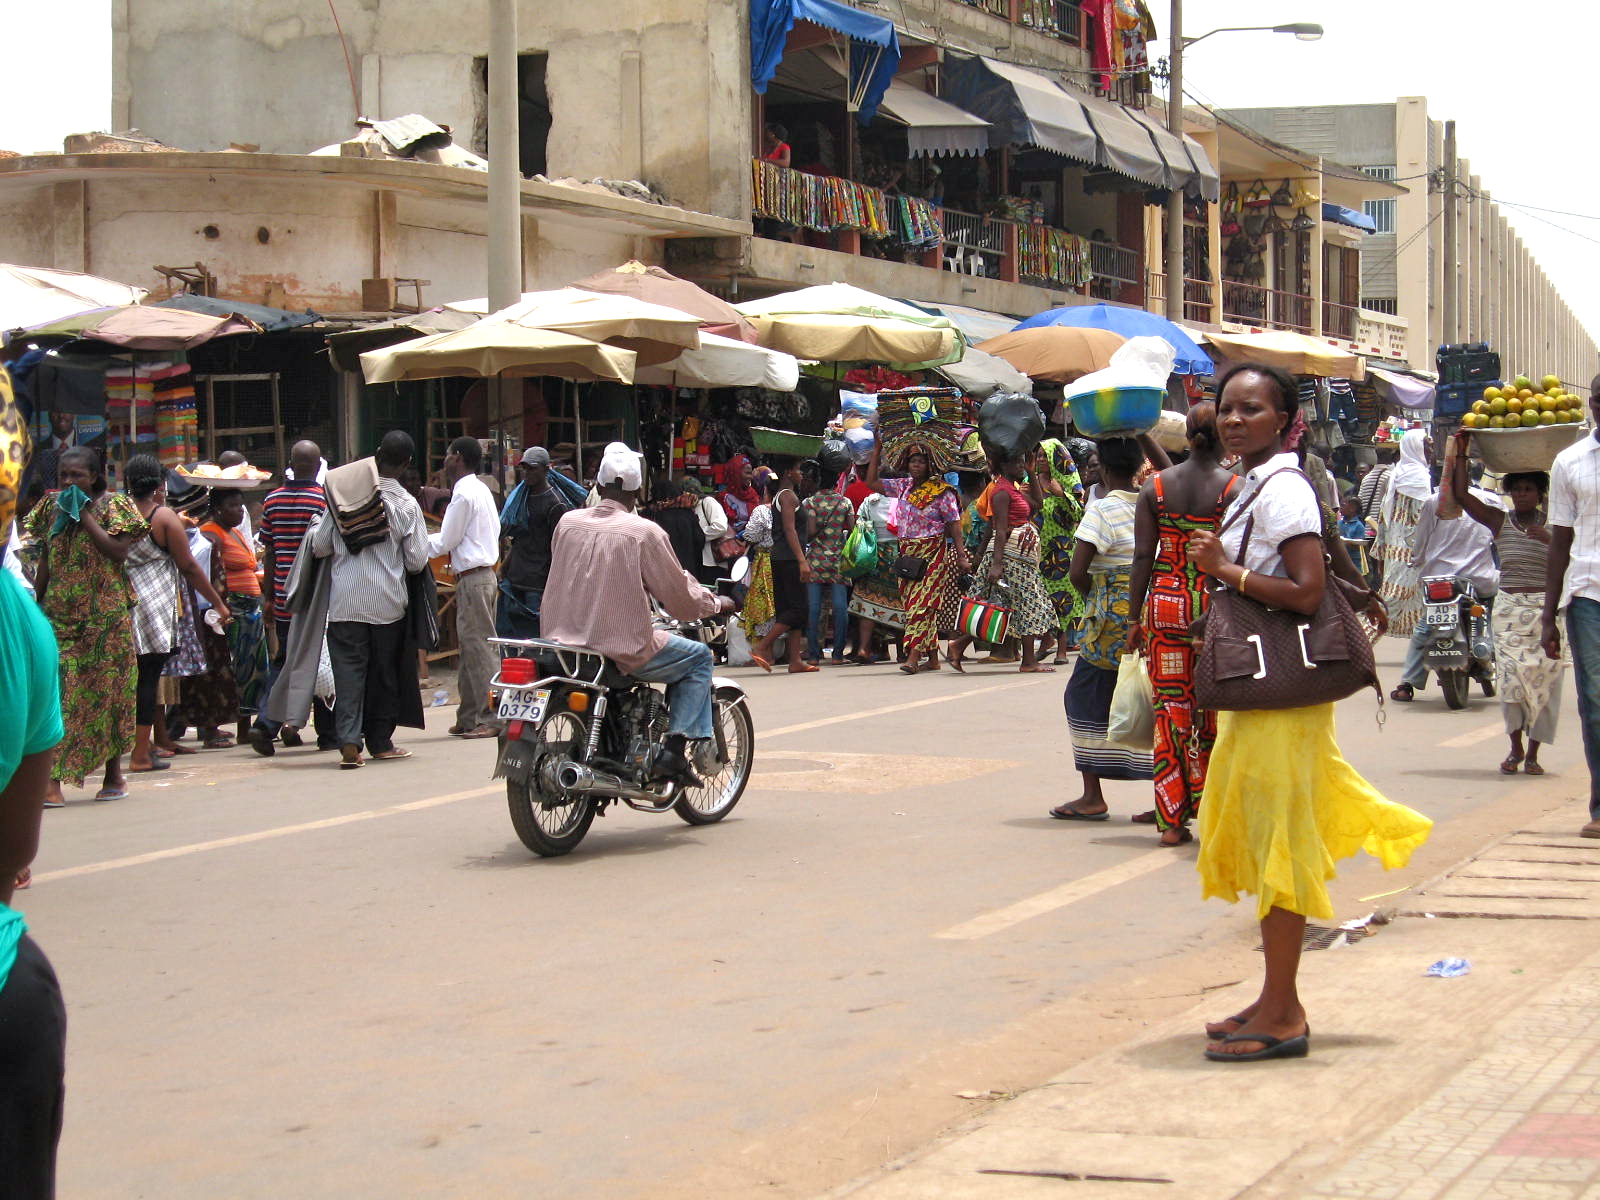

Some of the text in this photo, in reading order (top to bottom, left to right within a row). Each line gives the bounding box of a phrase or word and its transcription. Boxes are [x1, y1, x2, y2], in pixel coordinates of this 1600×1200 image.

[1435, 605, 1449, 614] AD
[1428, 613, 1457, 624] 6823
[512, 690, 534, 704] AG
[500, 703, 540, 719] 0379
